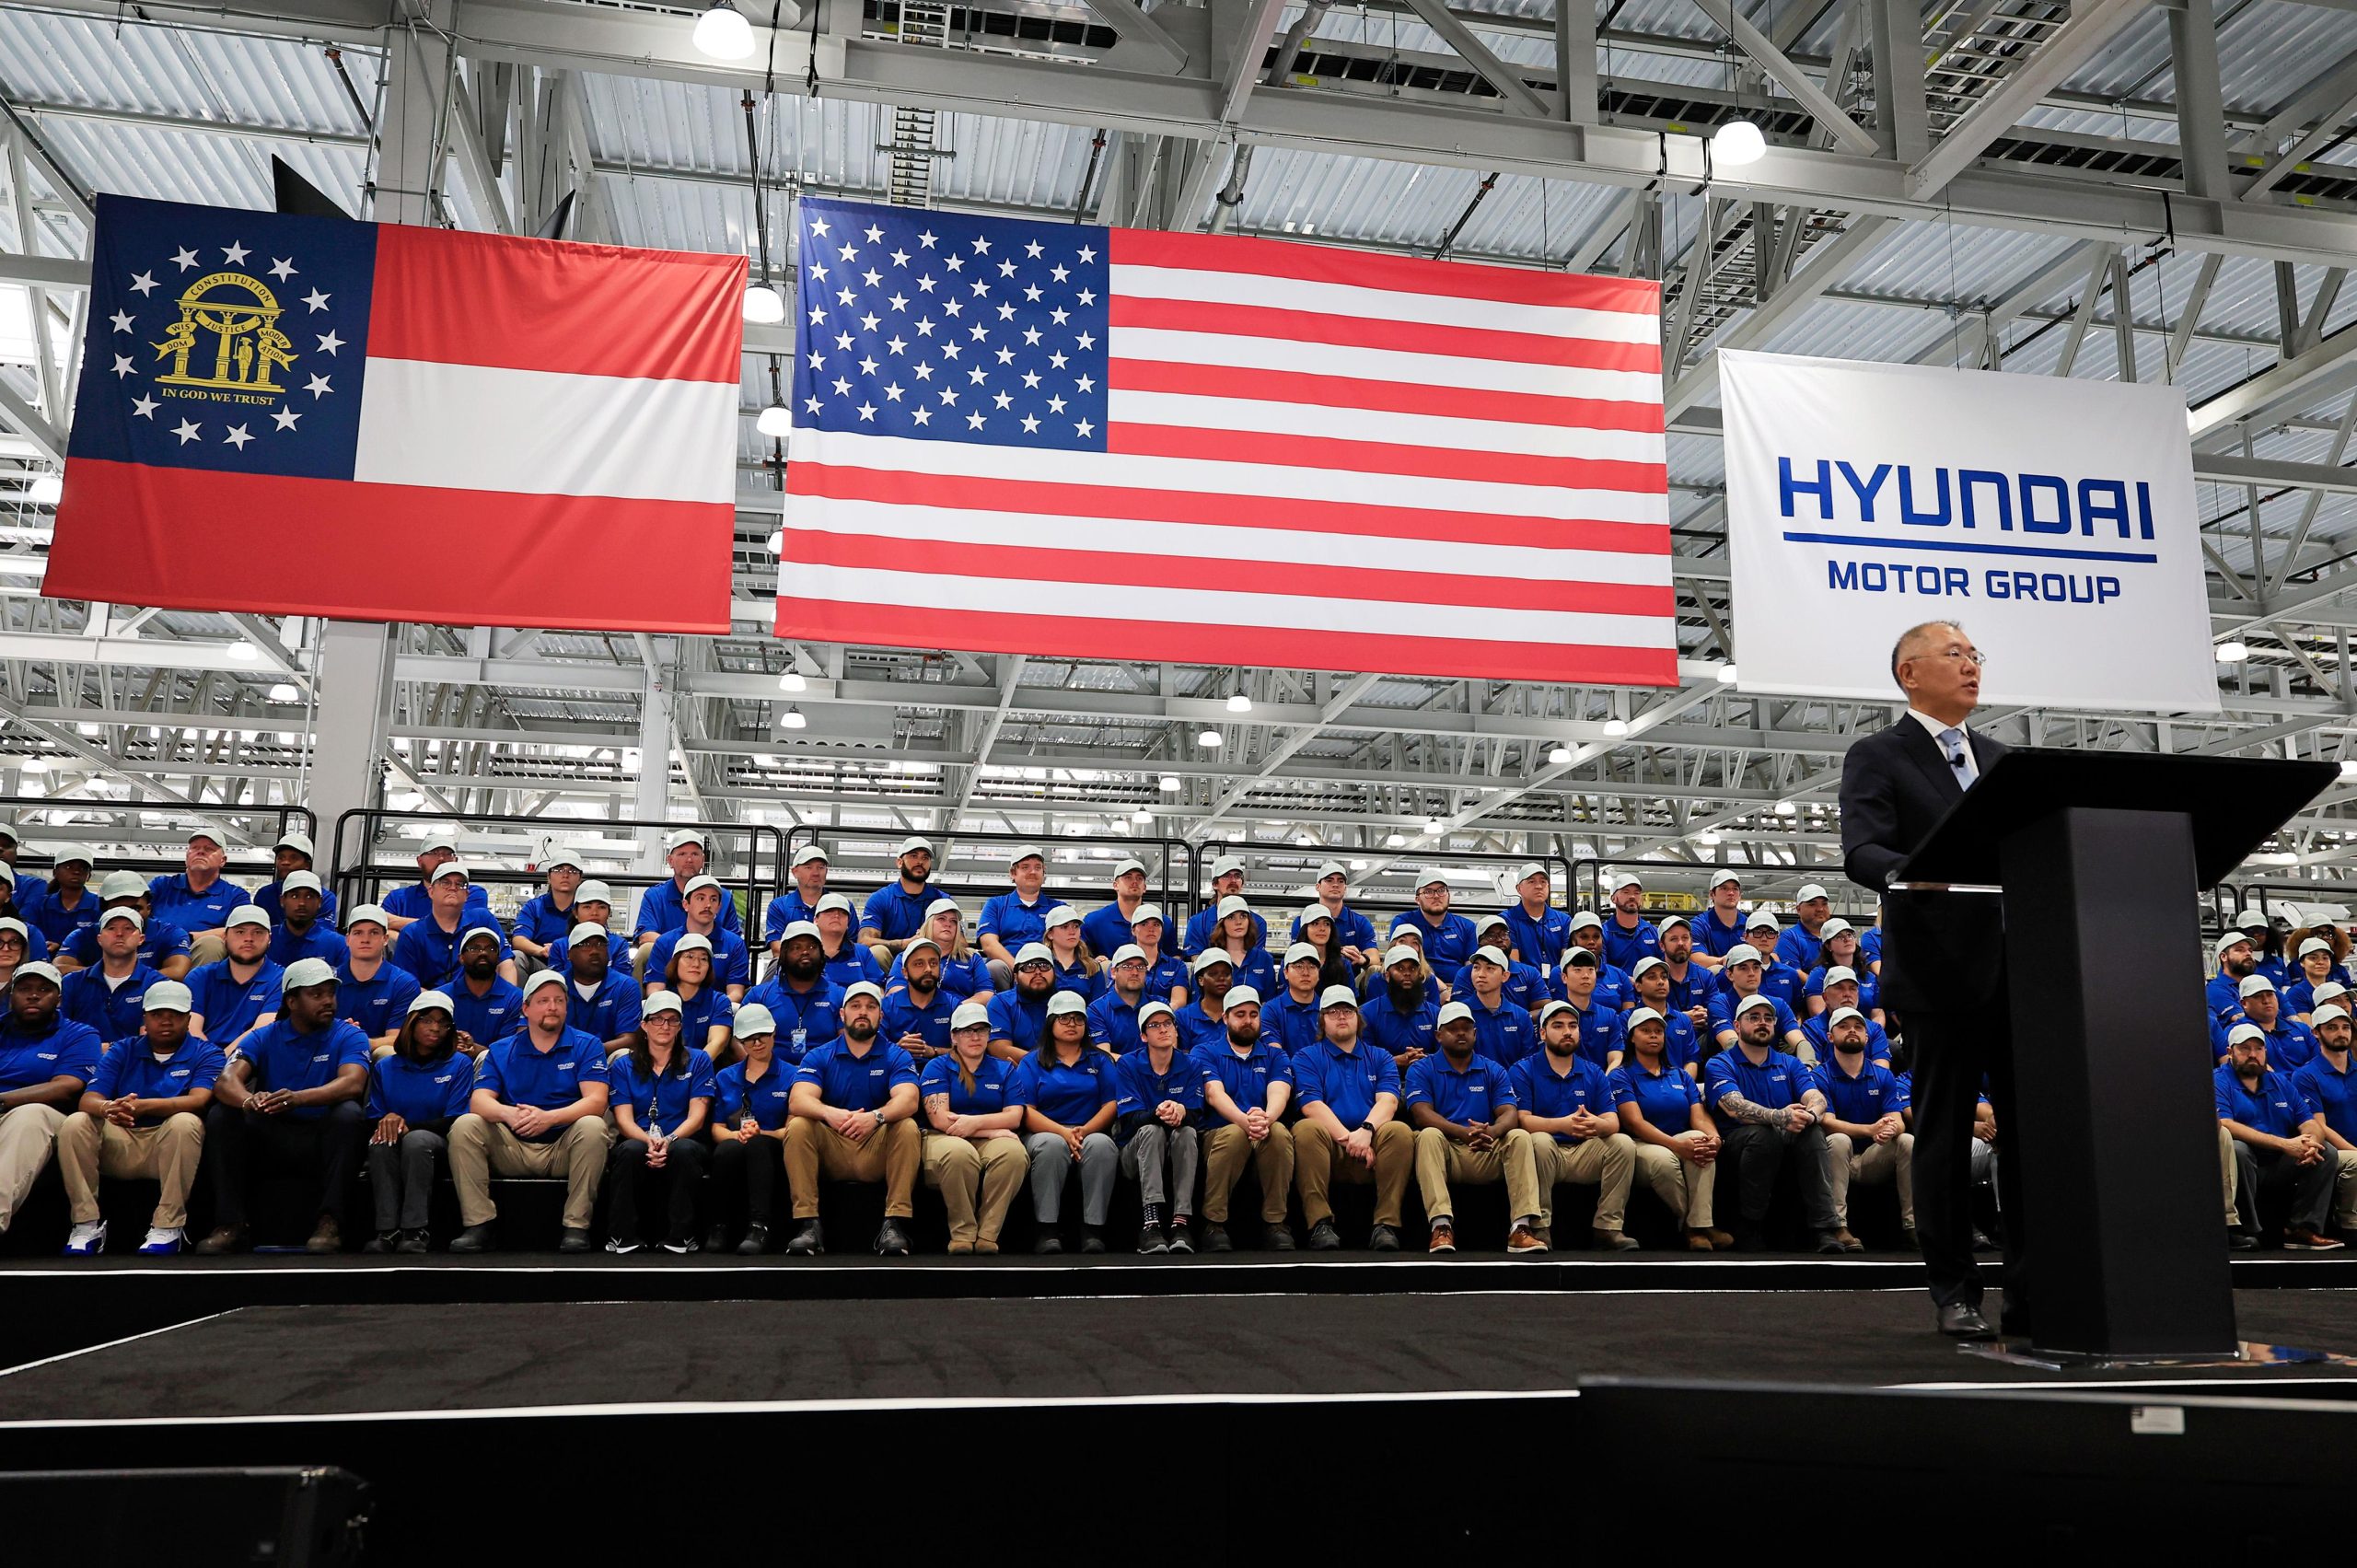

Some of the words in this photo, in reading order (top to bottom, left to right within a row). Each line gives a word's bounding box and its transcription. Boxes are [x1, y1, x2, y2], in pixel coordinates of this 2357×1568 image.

[191, 274, 272, 303] CONSTITUTION
[171, 323, 191, 332] WIS
[206, 321, 247, 333] JUSTICE
[167, 340, 188, 351] DOM
[261, 331, 287, 347] MODER
[261, 345, 285, 362] ATION
[162, 388, 178, 398] IN
[180, 390, 207, 400] GOD
[211, 393, 231, 402] WE
[233, 394, 275, 406] TRUST
[1778, 457, 2154, 540] HYUNDAI
[1828, 560, 1970, 597] MOTOR
[1986, 570, 2120, 604] GROUP
